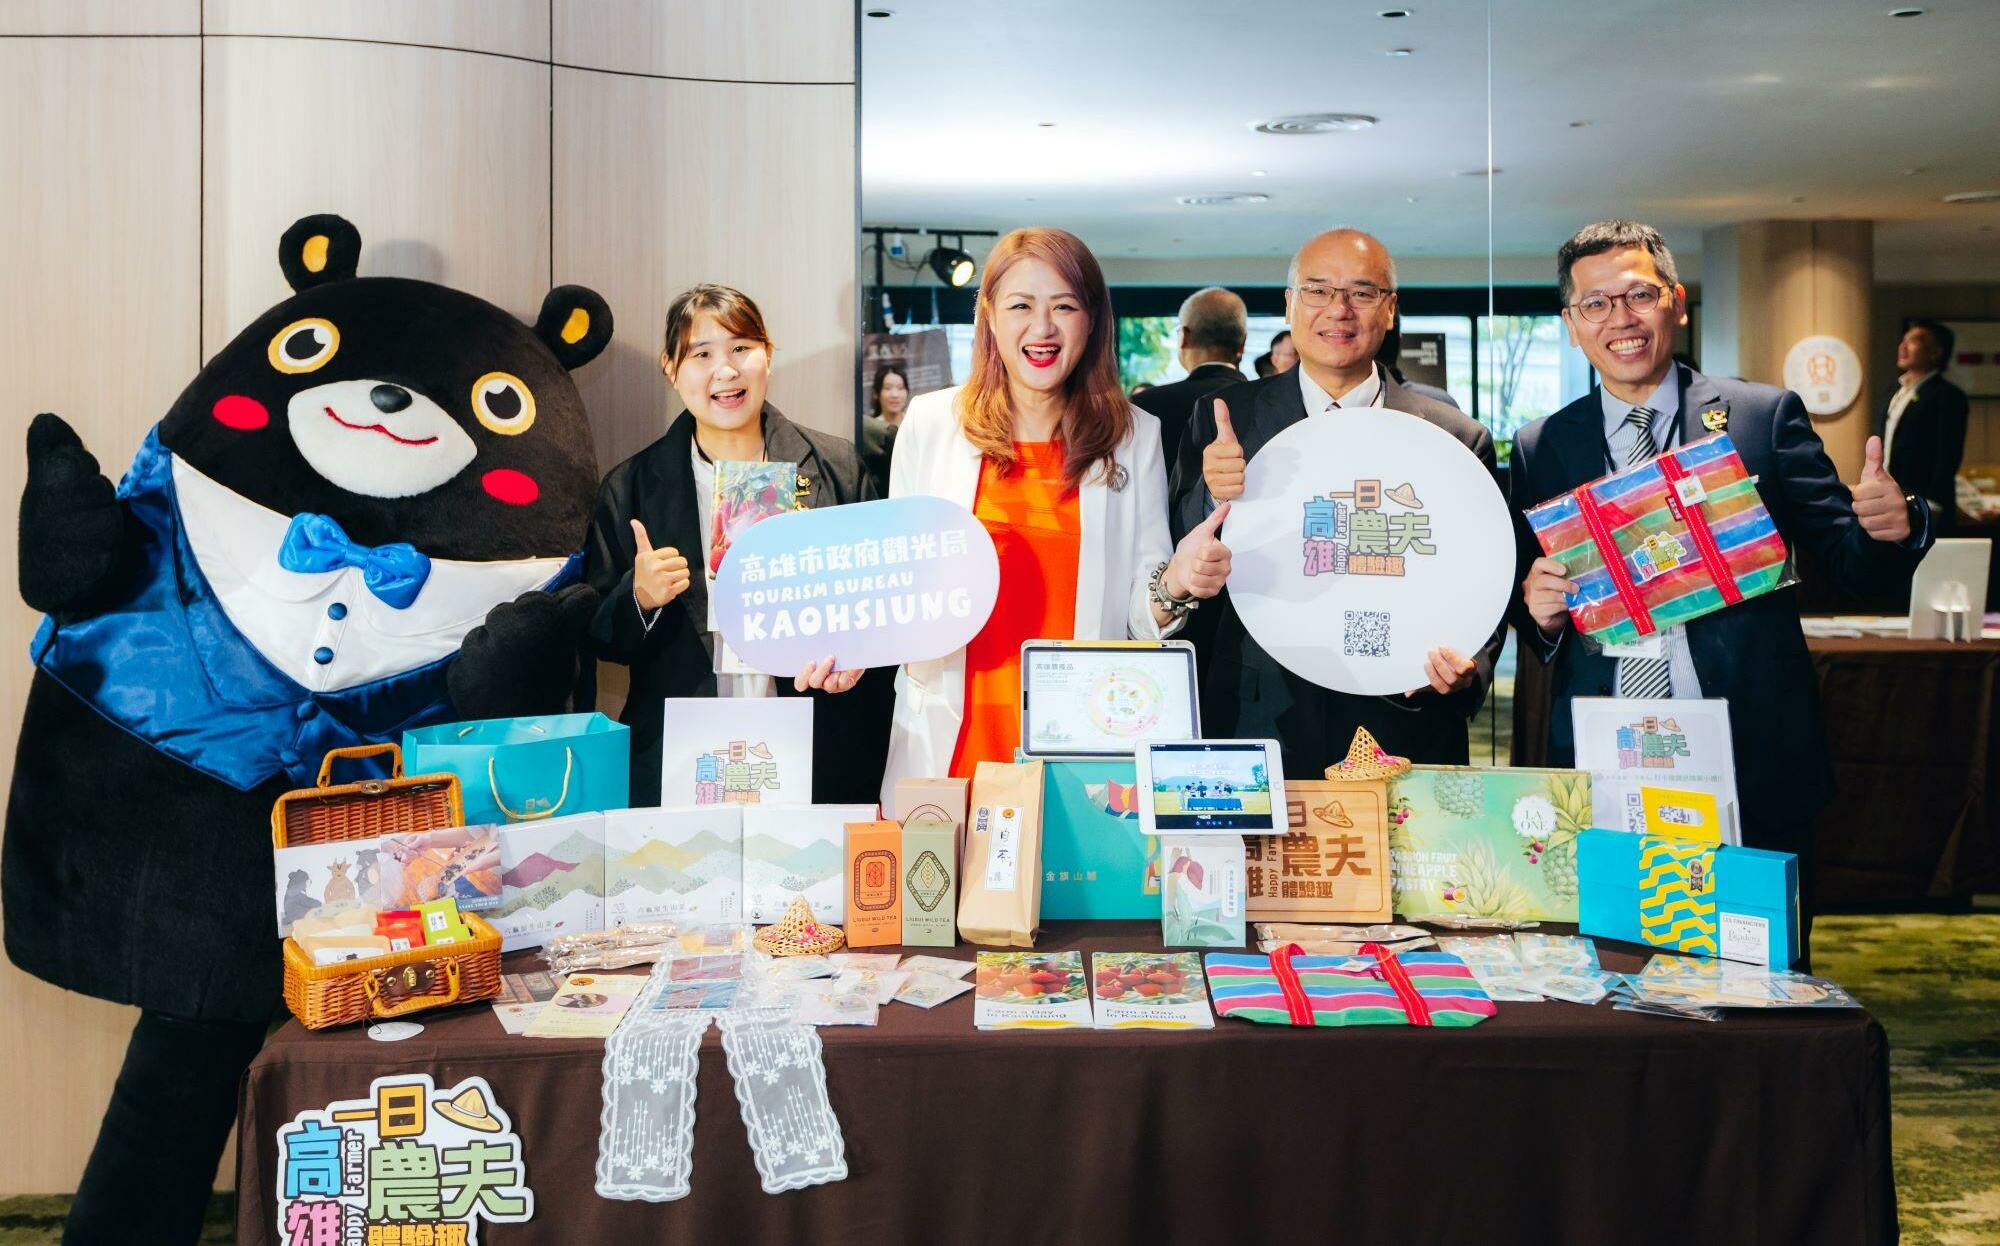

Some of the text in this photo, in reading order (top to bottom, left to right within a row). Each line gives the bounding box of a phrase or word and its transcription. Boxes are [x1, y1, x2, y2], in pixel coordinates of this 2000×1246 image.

[739, 528, 968, 585] 高雄市政府觀光局
[1303, 496, 1336, 576] 高雄
[1334, 502, 1348, 574] Happy Farmer
[1348, 509, 1436, 555] 農夫
[742, 571, 914, 608] TOURISM BUREAU
[743, 587, 972, 642] KAOHSIUNG
[1520, 821, 1547, 832] ONE
[1266, 835, 1279, 898] Happy Farm
[1282, 832, 1372, 877] 農夫
[1390, 863, 1457, 878] PINEAPPLE
[1431, 852, 1457, 863] FRUIT
[1282, 881, 1334, 899] 體驗趣
[1391, 878, 1437, 892] PASTRY
[284, 1120, 344, 1246] 高雄
[343, 1128, 365, 1246] appy Farmer
[368, 1139, 527, 1222] 農夫
